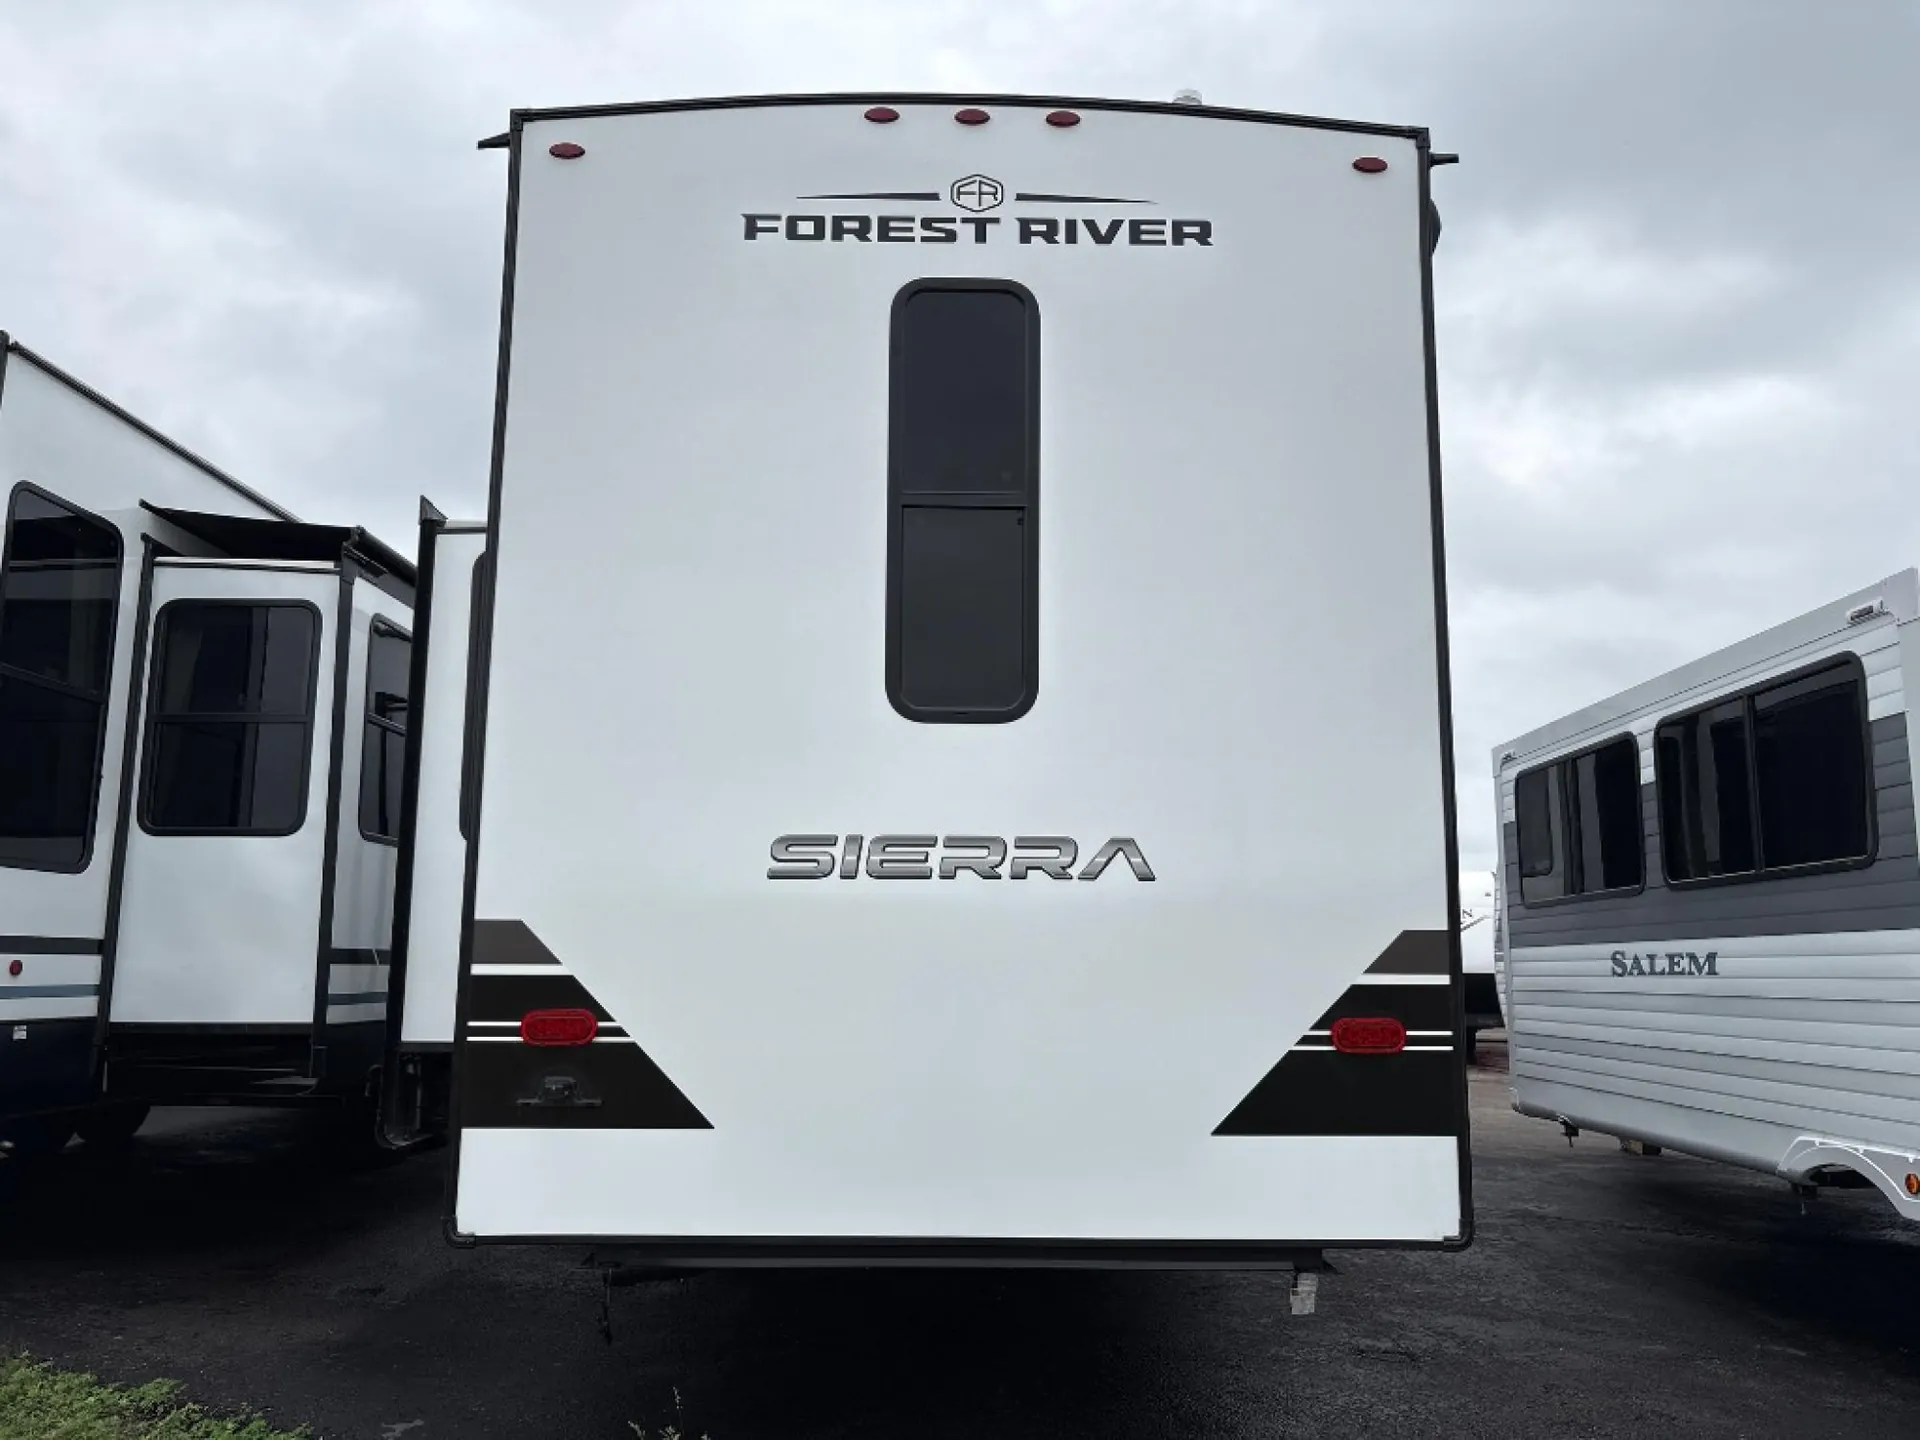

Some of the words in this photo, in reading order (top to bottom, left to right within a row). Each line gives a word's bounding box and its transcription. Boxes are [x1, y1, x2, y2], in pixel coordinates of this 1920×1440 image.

[740, 213, 1002, 244] FOREST
[1015, 218, 1214, 246] RIVER
[766, 834, 1157, 882] SIERRA
